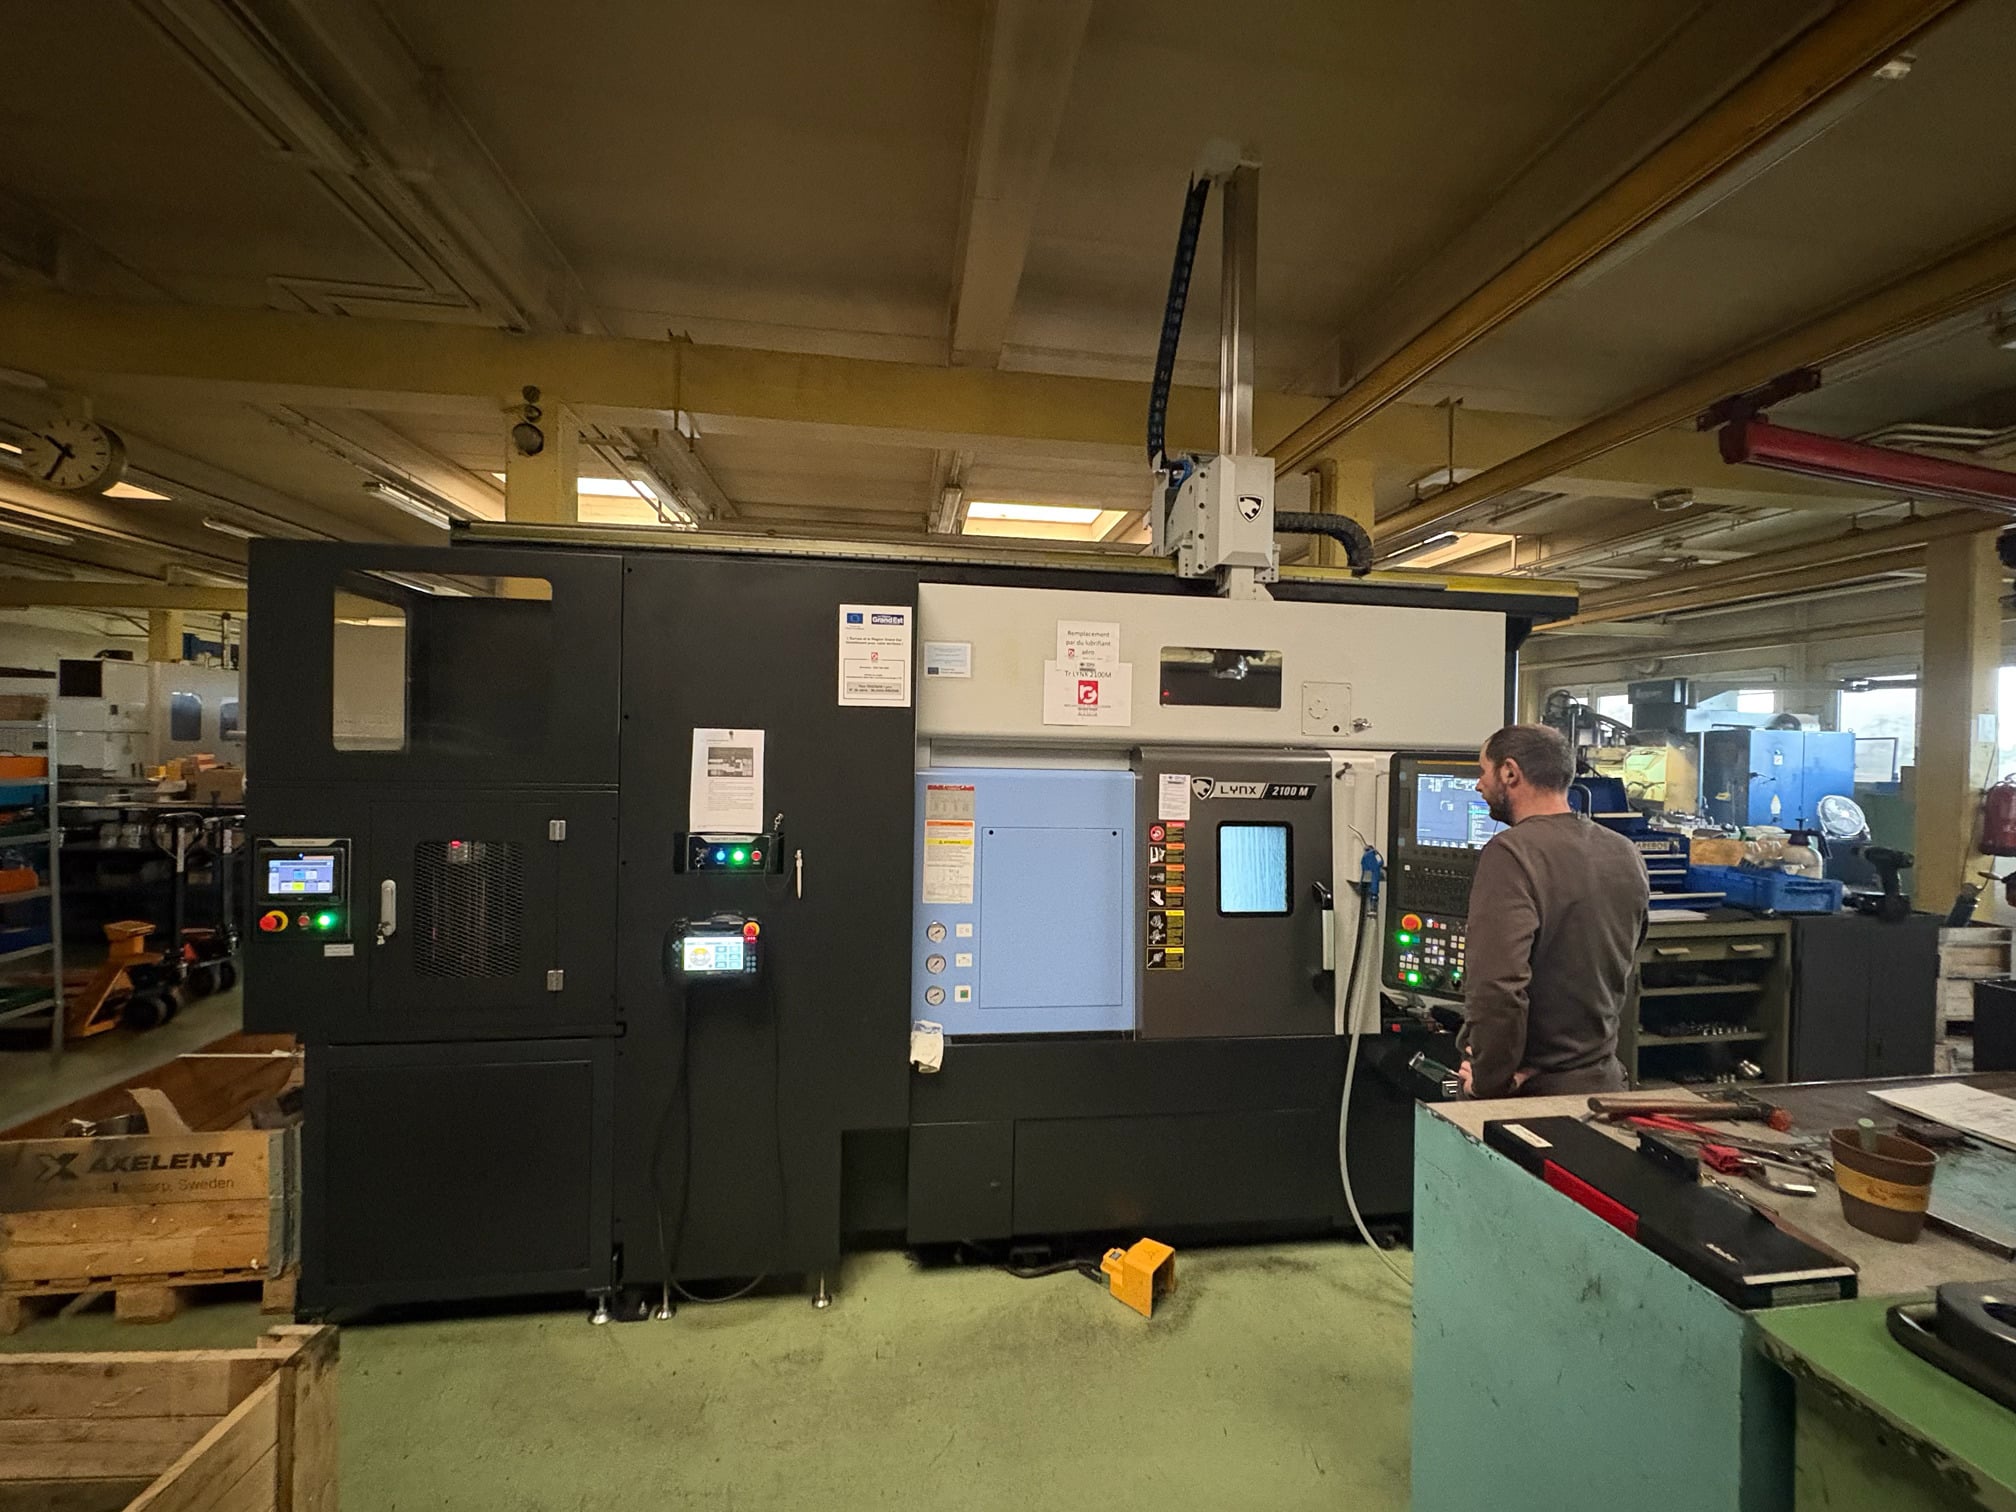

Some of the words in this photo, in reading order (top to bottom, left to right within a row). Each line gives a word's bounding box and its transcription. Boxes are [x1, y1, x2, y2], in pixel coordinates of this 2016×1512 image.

[1067, 630, 1110, 638] Remplacement
[1271, 786, 1297, 796] 2100
[1298, 787, 1309, 797] M
[87, 1151, 235, 1174] AXELENT
[178, 1176, 234, 1191] Sweden
